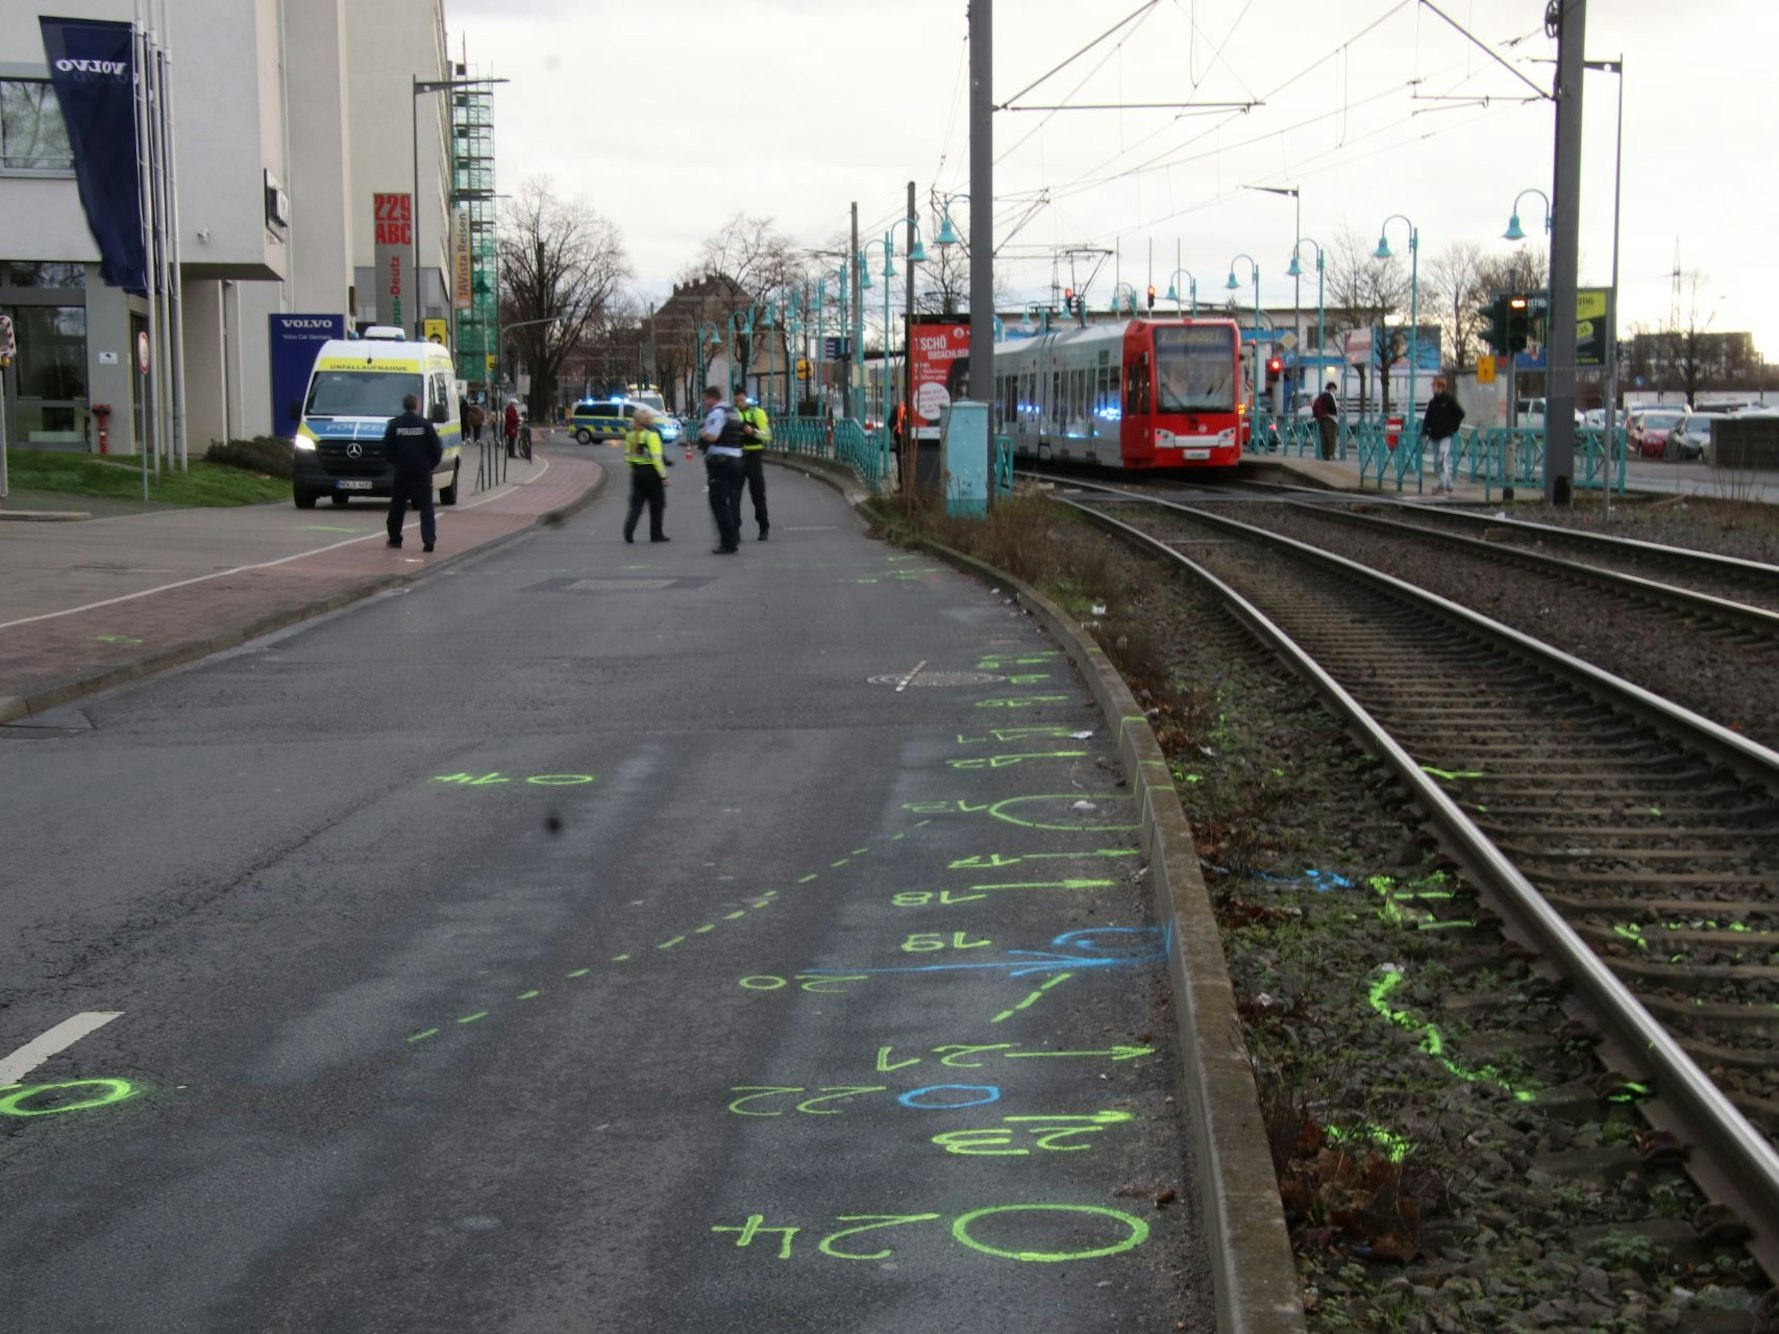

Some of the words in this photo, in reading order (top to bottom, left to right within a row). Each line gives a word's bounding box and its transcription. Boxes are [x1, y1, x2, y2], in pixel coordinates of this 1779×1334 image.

[374, 193, 411, 221] 229
[375, 222, 412, 245] ABC
[458, 213, 467, 253] Reisen
[281, 319, 333, 328] VOLVO
[891, 890, 987, 908] 18
[901, 931, 992, 952] 19
[738, 974, 869, 992] 20
[876, 1043, 1012, 1072] 21
[728, 1085, 887, 1116] 22
[710, 1212, 941, 1260] 24
